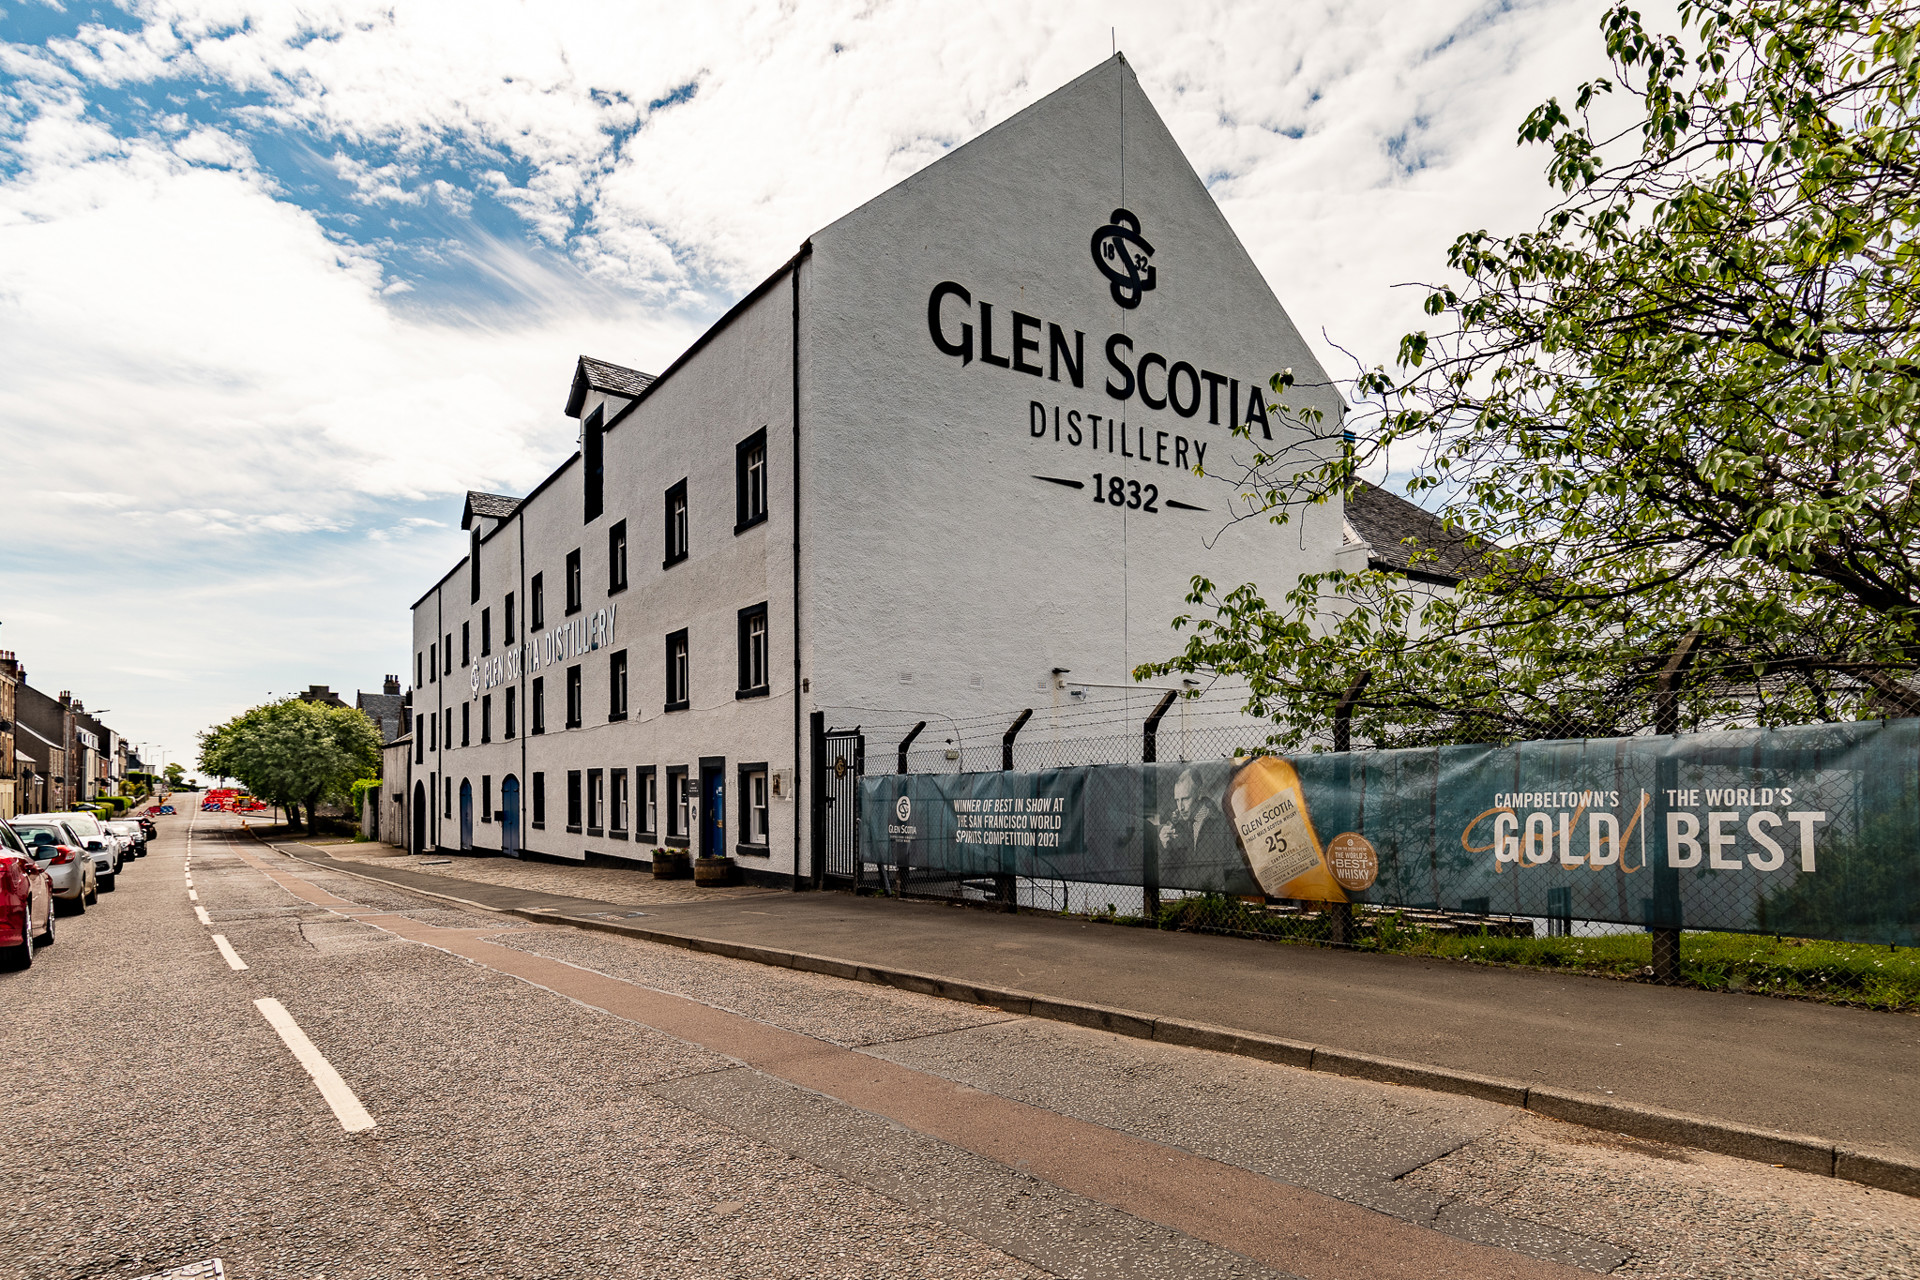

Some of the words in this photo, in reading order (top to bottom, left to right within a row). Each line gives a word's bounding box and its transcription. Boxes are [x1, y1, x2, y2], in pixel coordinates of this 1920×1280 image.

[1102, 241, 1115, 260] 18
[1133, 253, 1148, 273] 32
[927, 281, 1085, 388] GLEN
[1105, 333, 1273, 440] SCOTIA
[1030, 400, 1207, 470] DISTILLERY
[1092, 473, 1159, 513] 1832
[484, 655, 505, 690] GLEN
[545, 603, 618, 666] DISTILLERY
[953, 799, 982, 813] WINNER
[982, 799, 994, 812] OF
[994, 799, 1013, 812] BEST
[1014, 799, 1024, 812] IN
[1026, 798, 1052, 812] SHOW
[1053, 798, 1065, 812] AT
[1494, 790, 1619, 808] CAMPBELTOWN'S
[1667, 789, 1699, 807] THE
[1705, 787, 1793, 807] WORLD'S
[888, 824, 901, 834] GLEN
[956, 814, 967, 828] THE
[968, 815, 982, 828] SAN
[984, 814, 1028, 829] FRANCISCO
[1029, 815, 1062, 830] WORLD
[1241, 816, 1263, 837] GLEN
[1262, 799, 1294, 825] SCOTIA
[1267, 819, 1283, 833] SCOTCH
[1283, 810, 1298, 822] WHISKY
[955, 830, 982, 844] SPIRITS
[983, 831, 1036, 847] COMPETITION
[1037, 832, 1059, 847] 2021
[1265, 829, 1287, 853] 25
[1494, 812, 1620, 866] GOLD
[1667, 811, 1826, 873] BEST
[1335, 851, 1345, 859] THE
[1345, 852, 1368, 860] WORLD'S
[1335, 858, 1369, 869] BEST
[1336, 868, 1369, 881] WHISKY
